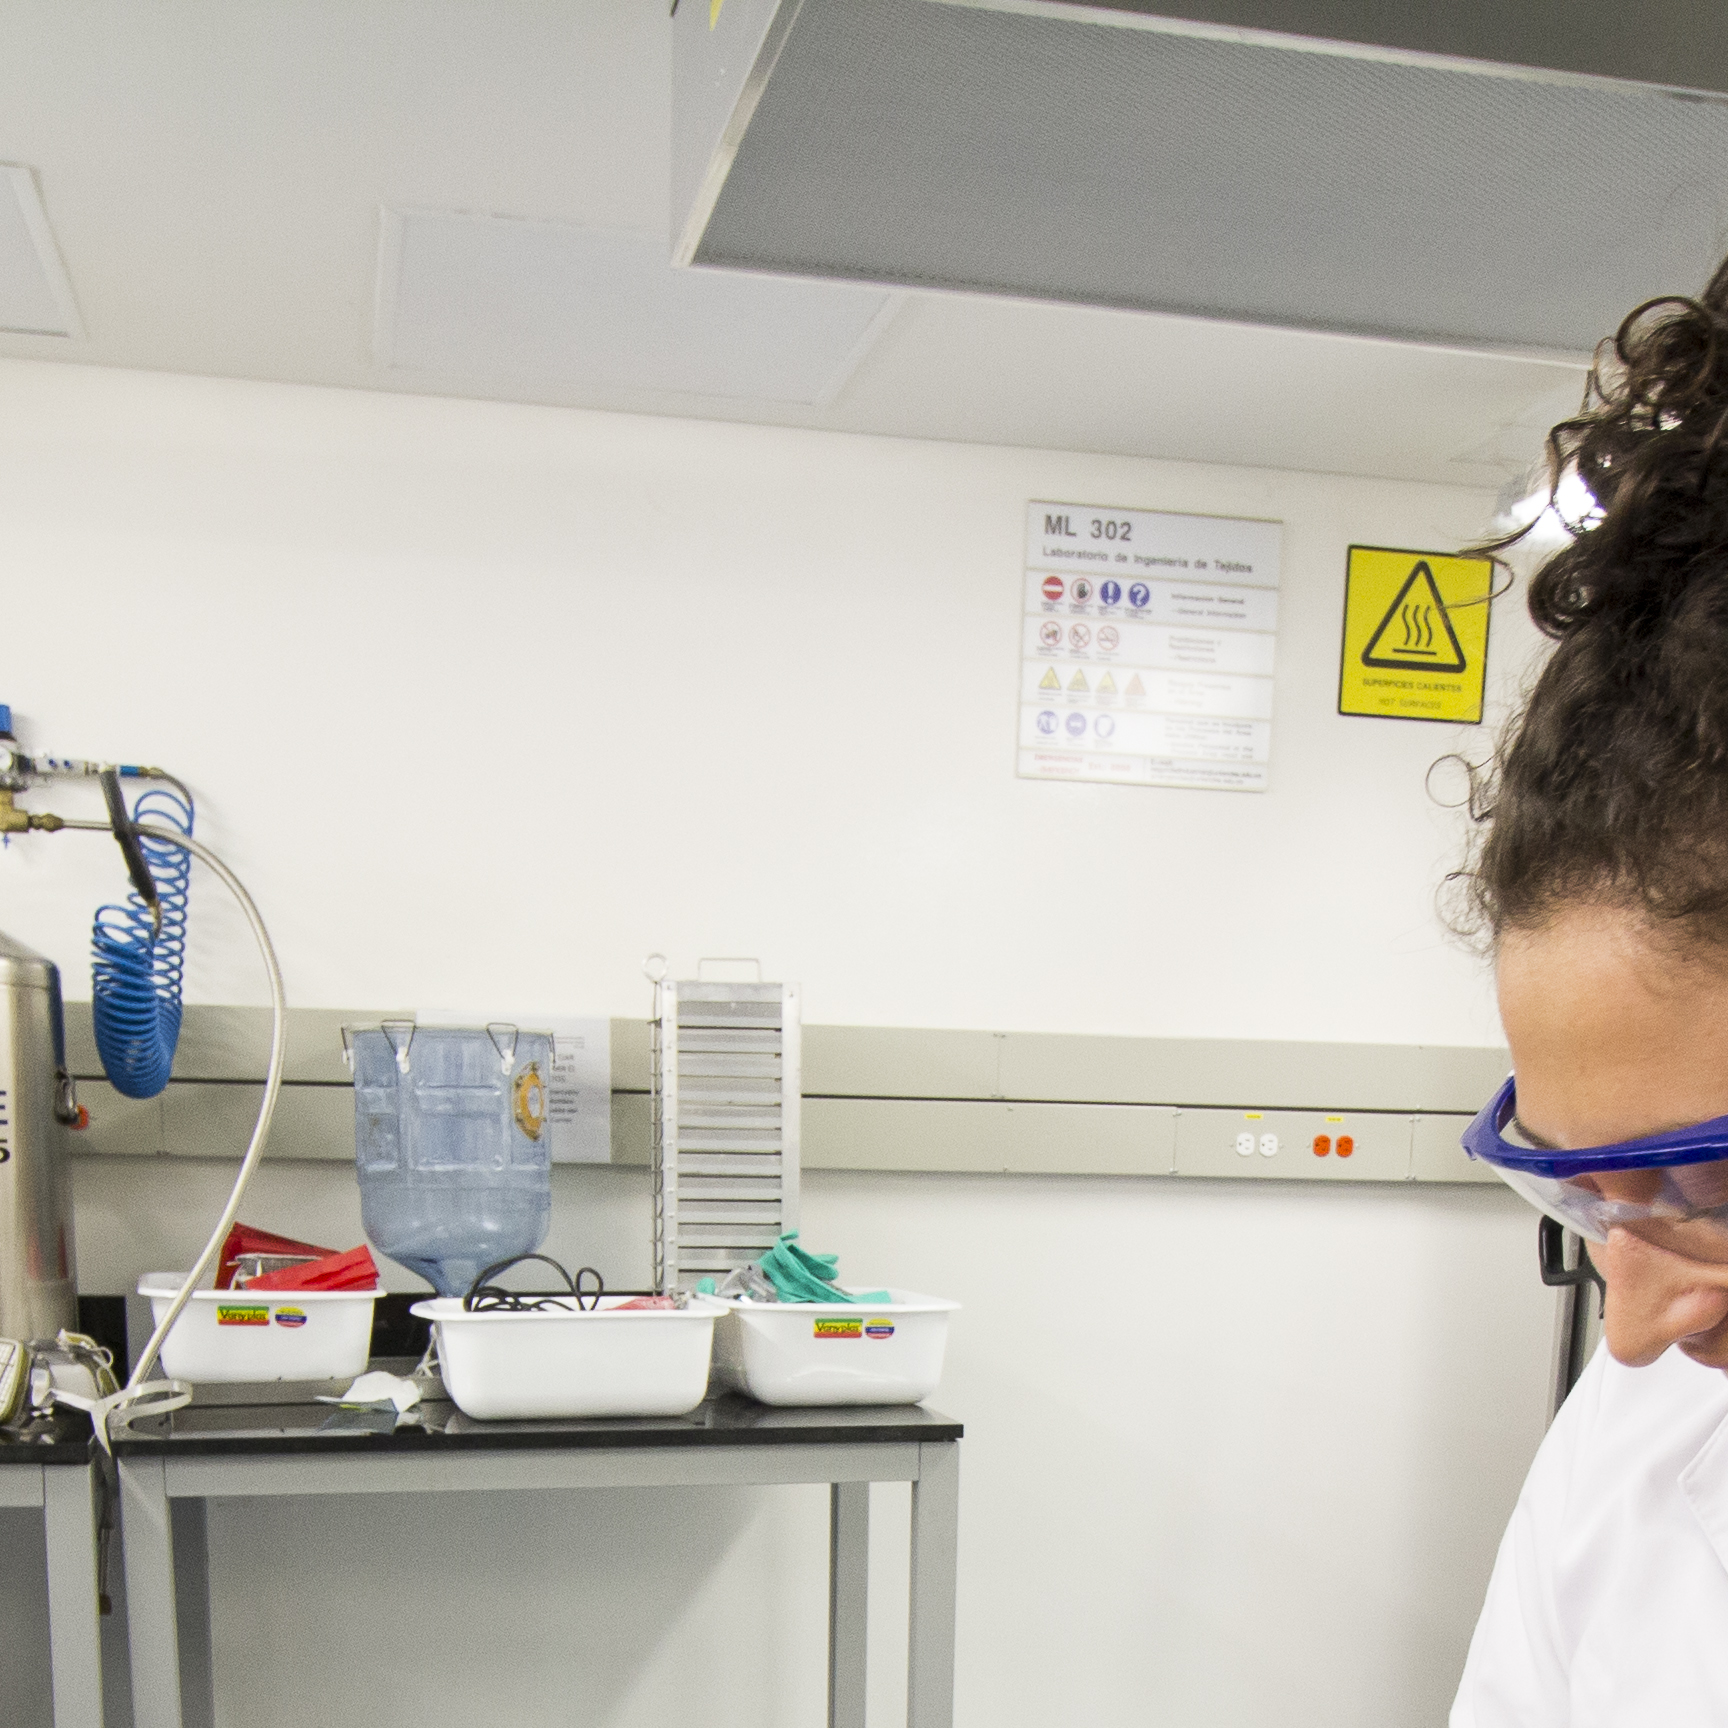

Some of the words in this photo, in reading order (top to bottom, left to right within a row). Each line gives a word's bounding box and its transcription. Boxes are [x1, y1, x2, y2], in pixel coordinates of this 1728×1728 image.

[1044, 514, 1077, 537] ML
[1090, 519, 1133, 542] 302
[1042, 546, 1109, 562] Laboratorio
[1114, 550, 1128, 563] de
[1194, 557, 1207, 570] de
[1214, 559, 1253, 574] Tejidos
[1362, 677, 1414, 690] SUPERFICIES
